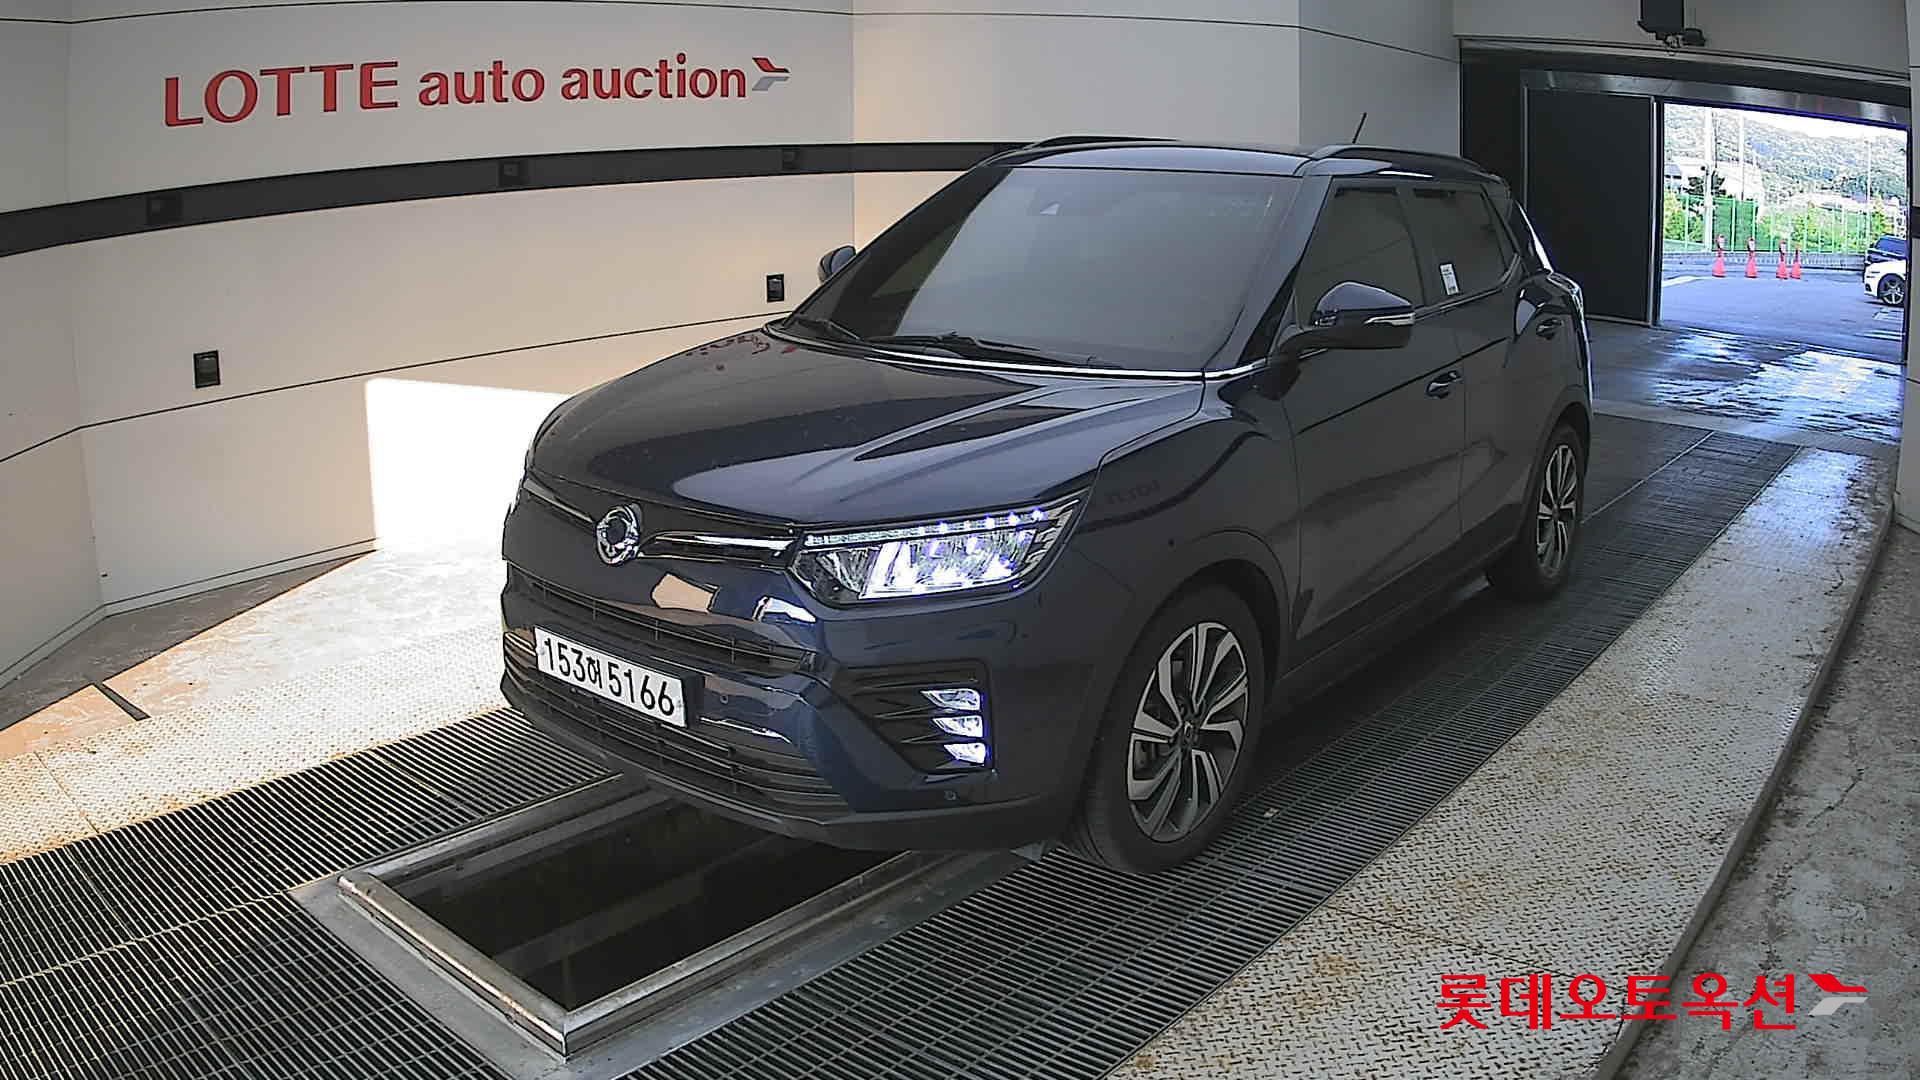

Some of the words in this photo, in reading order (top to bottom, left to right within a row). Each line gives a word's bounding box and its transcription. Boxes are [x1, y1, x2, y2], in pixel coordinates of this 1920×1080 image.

[164, 61, 399, 127] LOTTE
[418, 60, 545, 106] auto
[561, 53, 746, 101] auction
